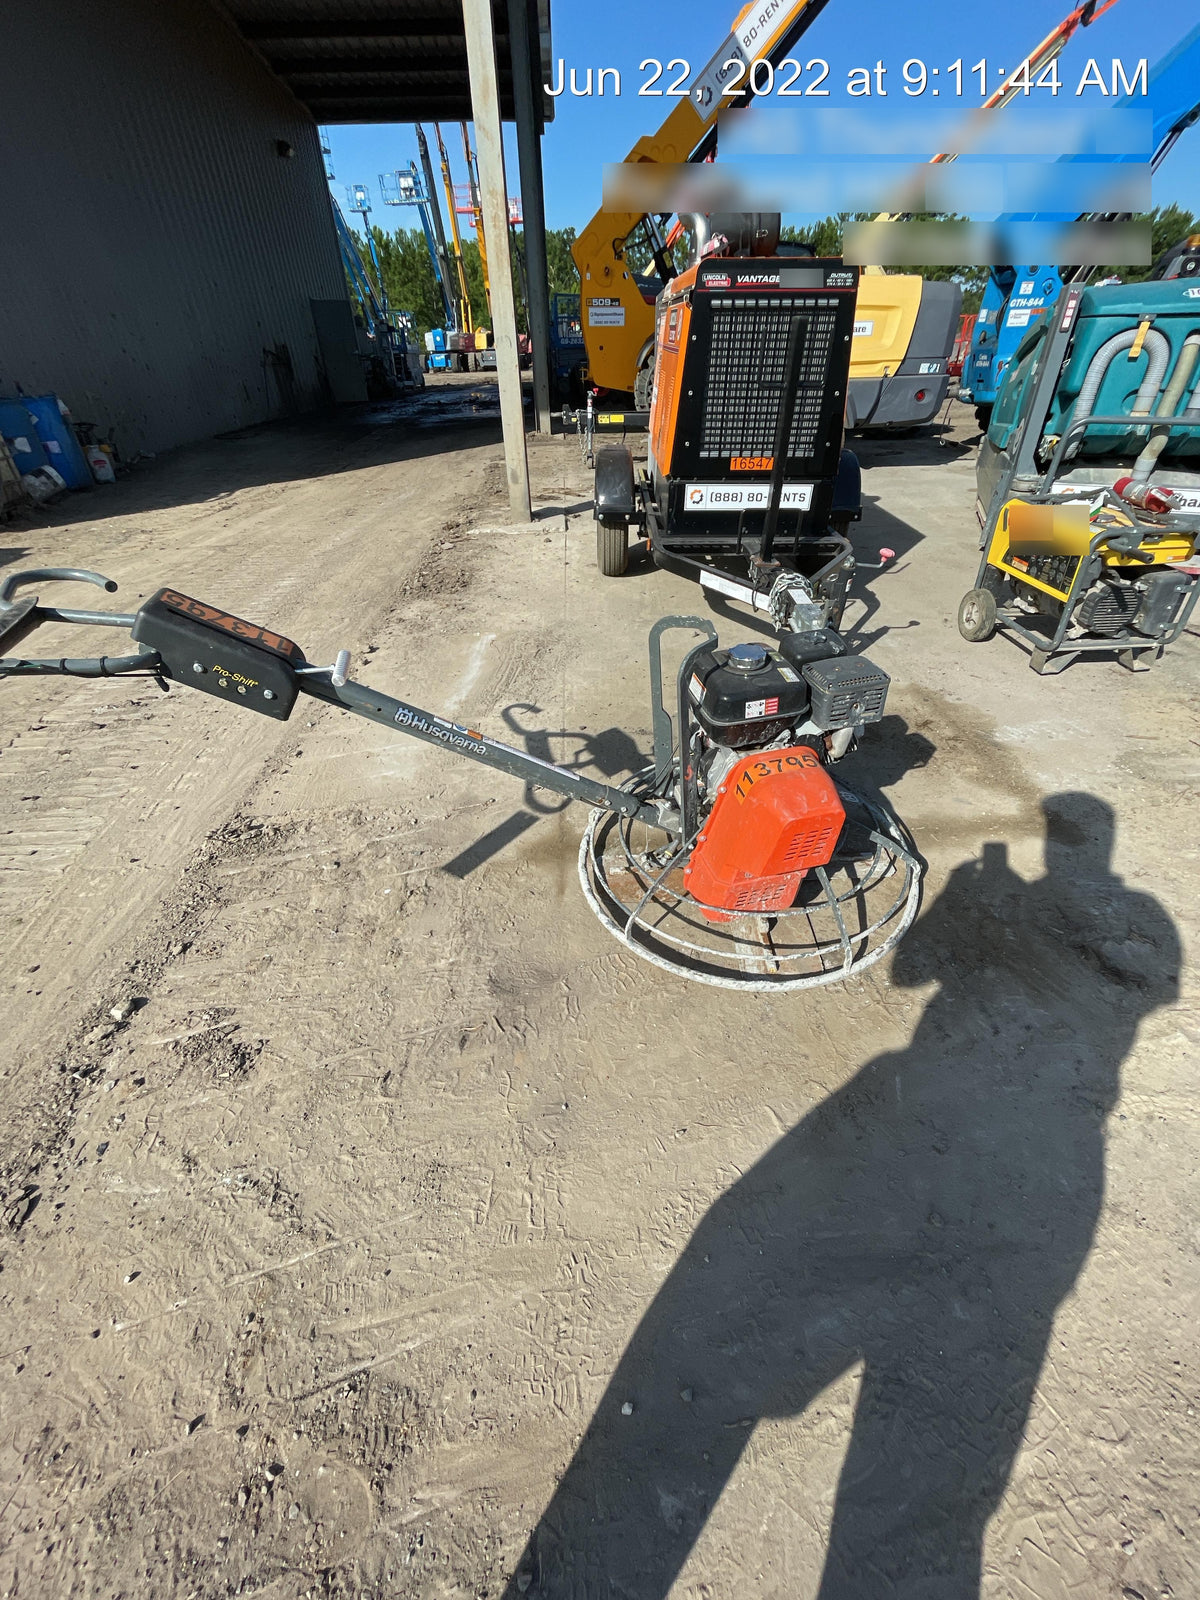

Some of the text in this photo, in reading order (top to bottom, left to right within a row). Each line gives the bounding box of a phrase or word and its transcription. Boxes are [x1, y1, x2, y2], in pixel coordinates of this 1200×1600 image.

[743, 0, 784, 48] 80-REN
[1009, 297, 1045, 308] GTH-844
[732, 458, 772, 470] 16547
[710, 492, 806, 503] (888) 80-NTS
[411, 715, 487, 756] Husqvarna
[735, 754, 818, 798] 113795
